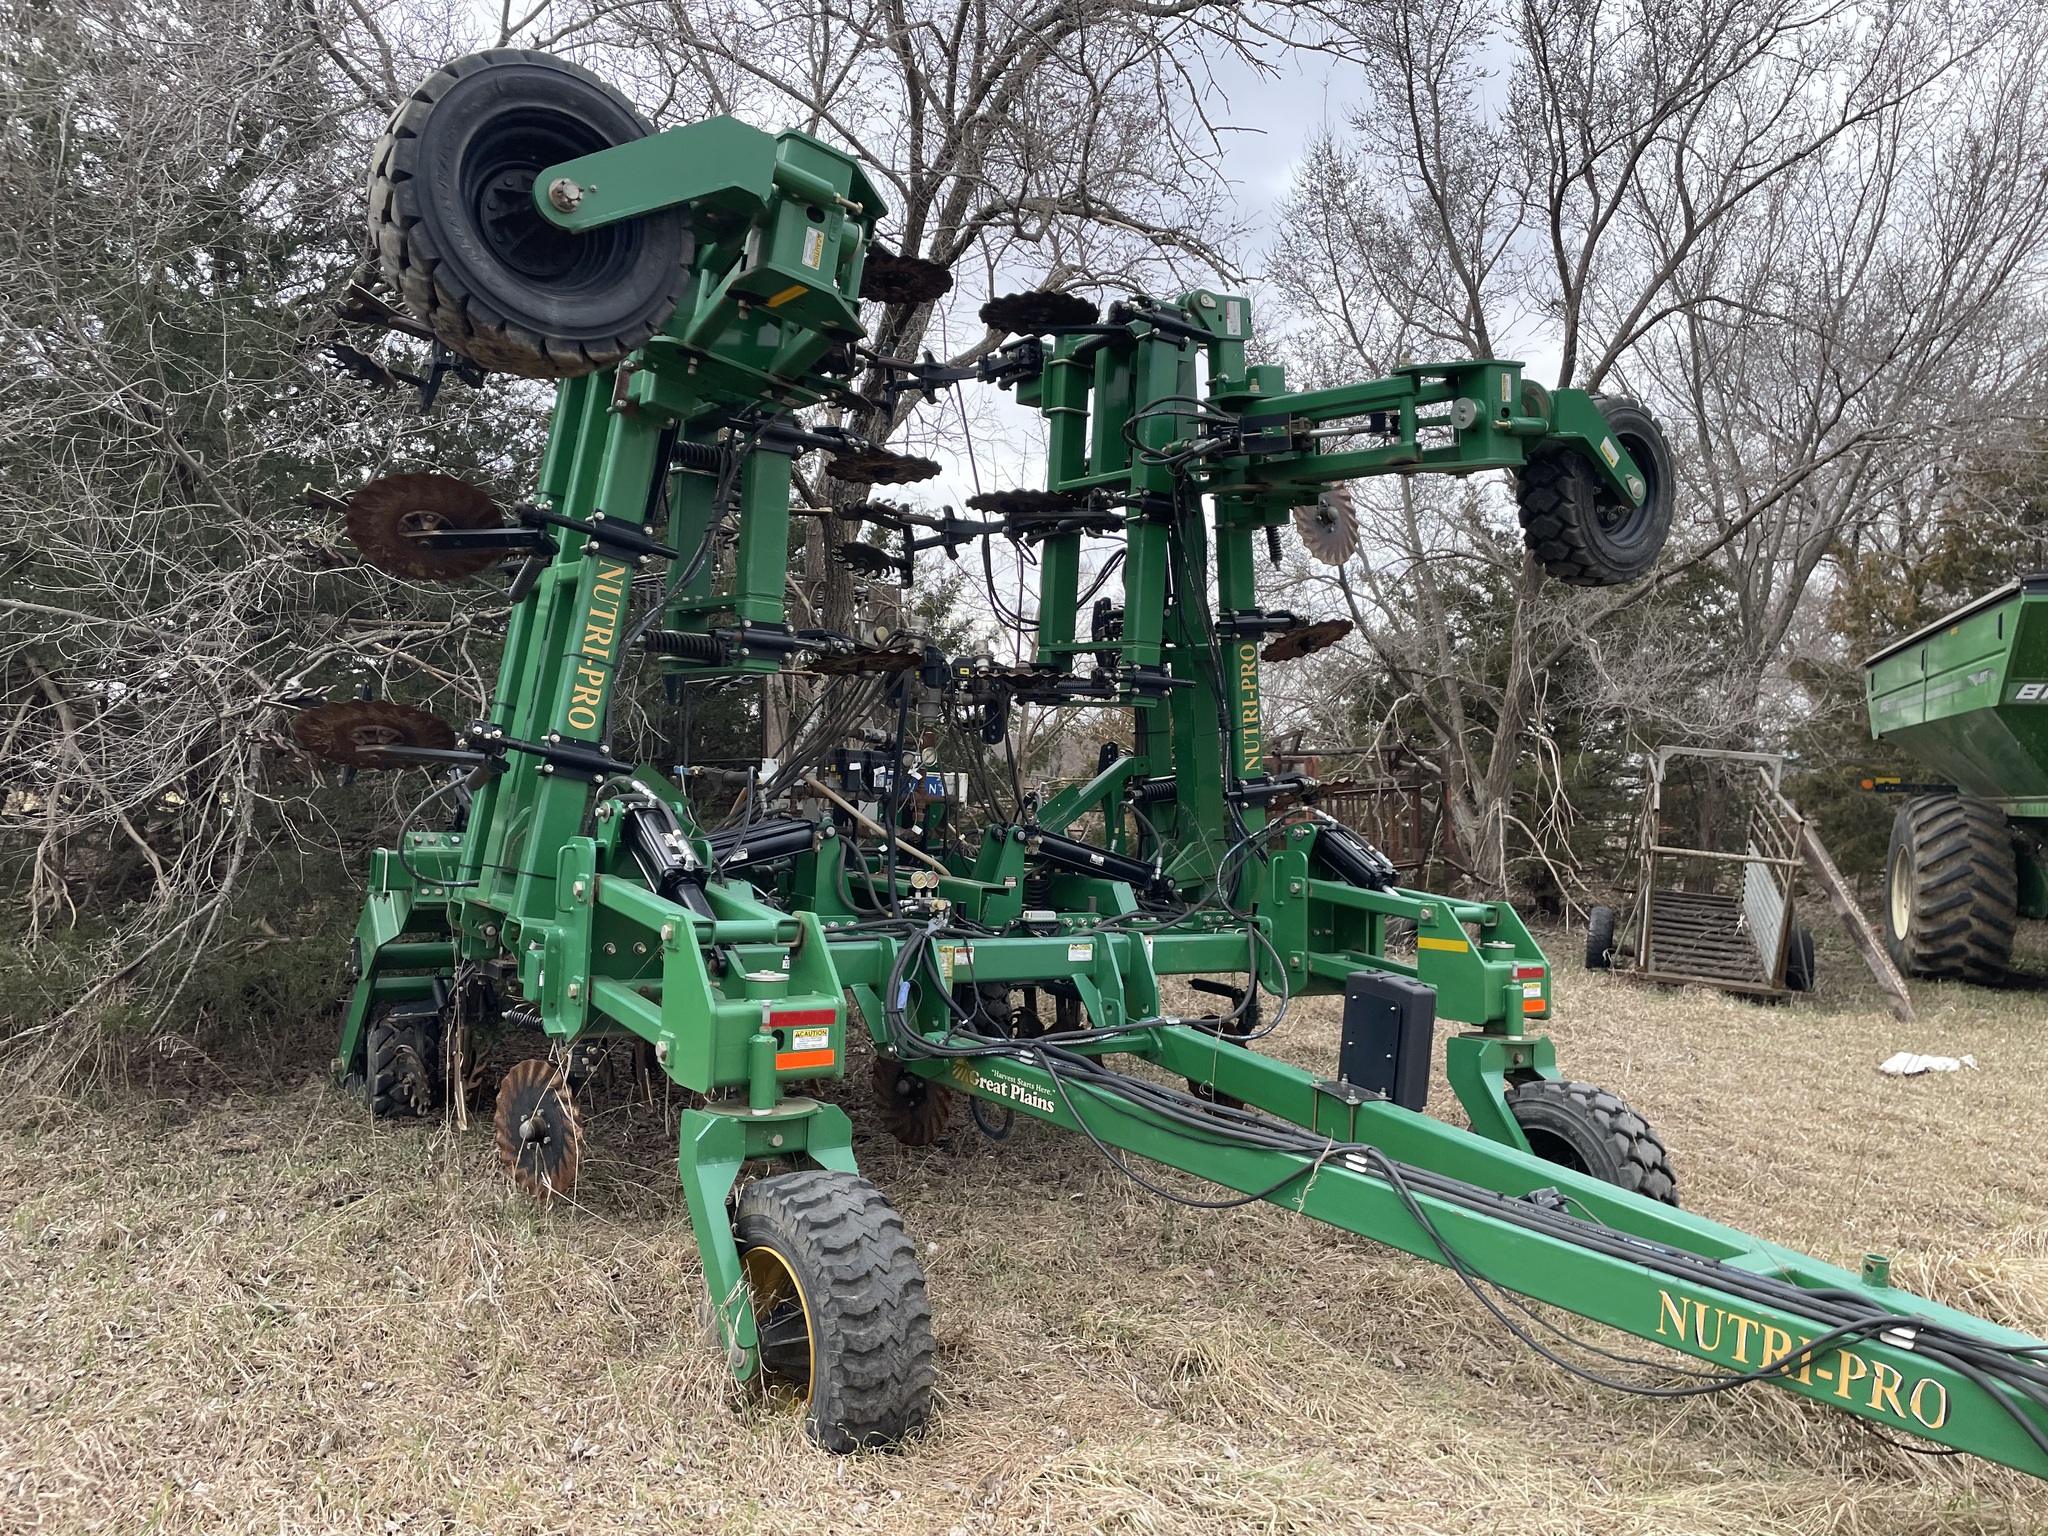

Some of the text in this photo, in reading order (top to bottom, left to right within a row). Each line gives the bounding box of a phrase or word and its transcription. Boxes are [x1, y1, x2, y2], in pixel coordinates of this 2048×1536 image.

[813, 237, 823, 267] CAUTION
[567, 559, 627, 730] NUTRI-PRO
[1239, 643, 1262, 772] NUTRI-PRO
[969, 1070, 1056, 1113] Great Plains
[1016, 1077, 1035, 1089] Starts
[1655, 1289, 1952, 1430] NUTRI-PRO
